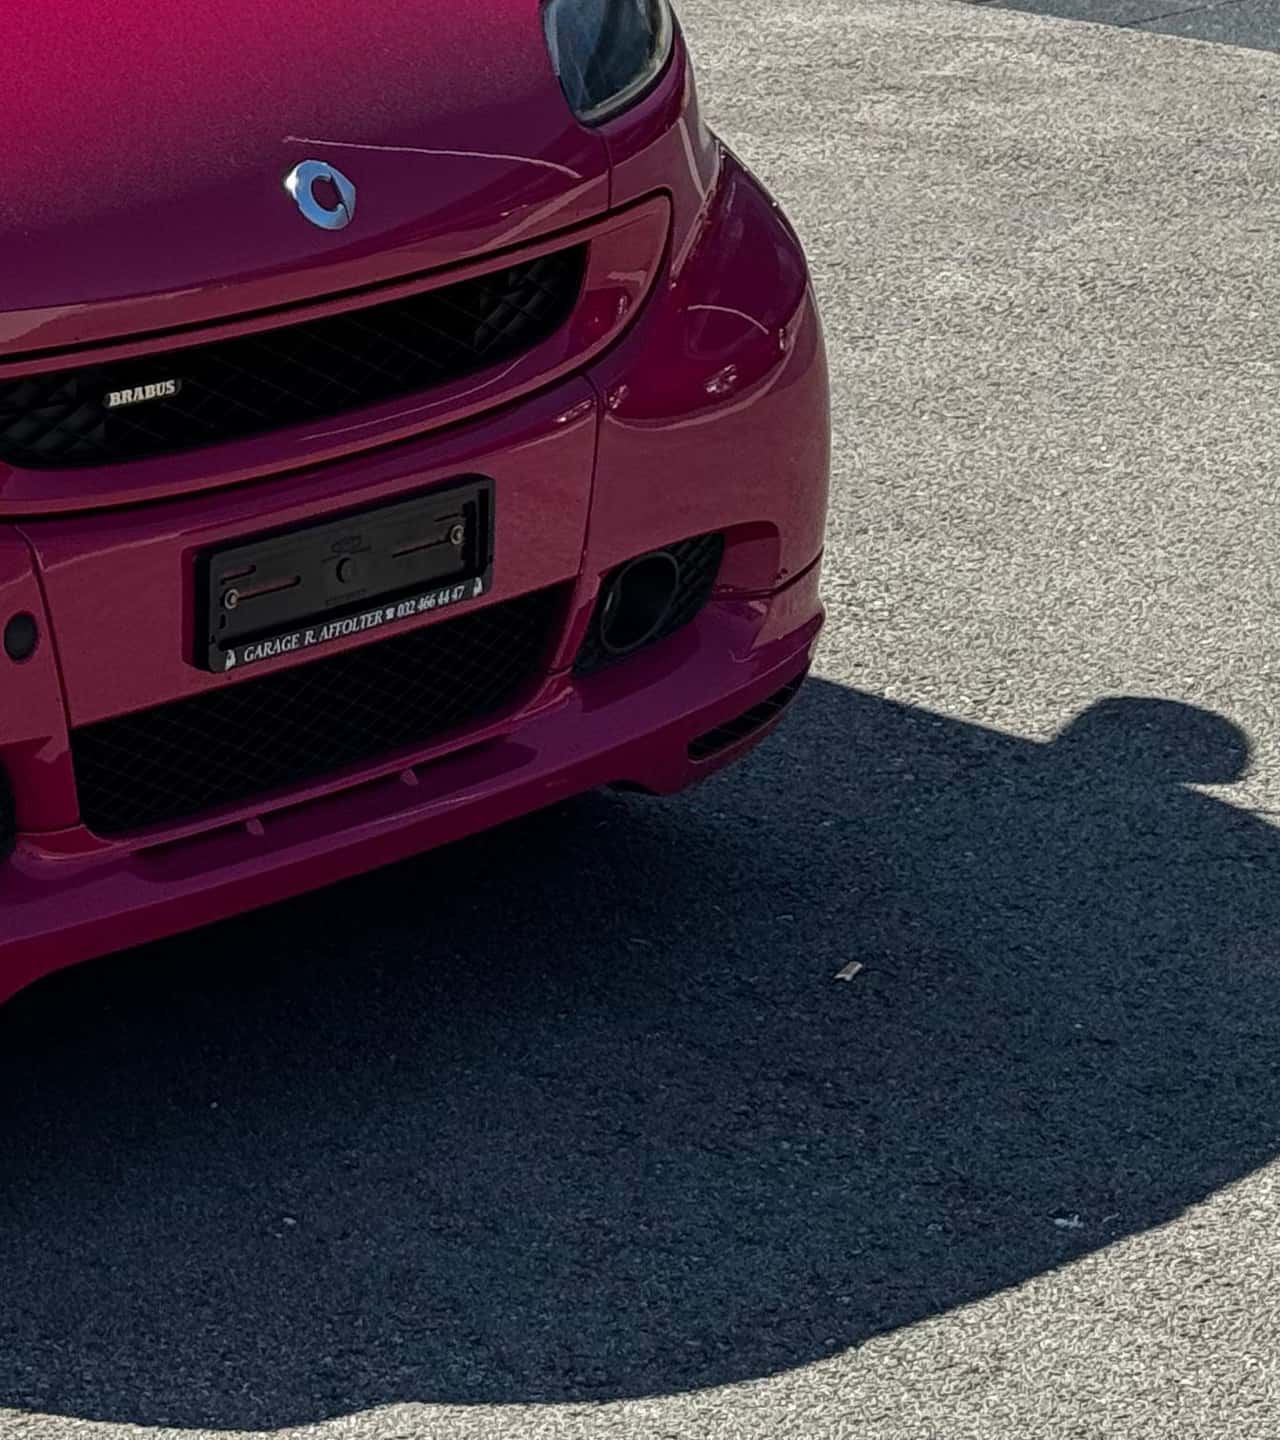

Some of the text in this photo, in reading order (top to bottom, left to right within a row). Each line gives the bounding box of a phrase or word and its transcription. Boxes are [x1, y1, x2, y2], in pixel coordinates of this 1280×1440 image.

[108, 379, 176, 408] BRABUS
[243, 632, 301, 662] GARAGE
[319, 609, 383, 641] AFFOLTER
[396, 600, 416, 618] 032
